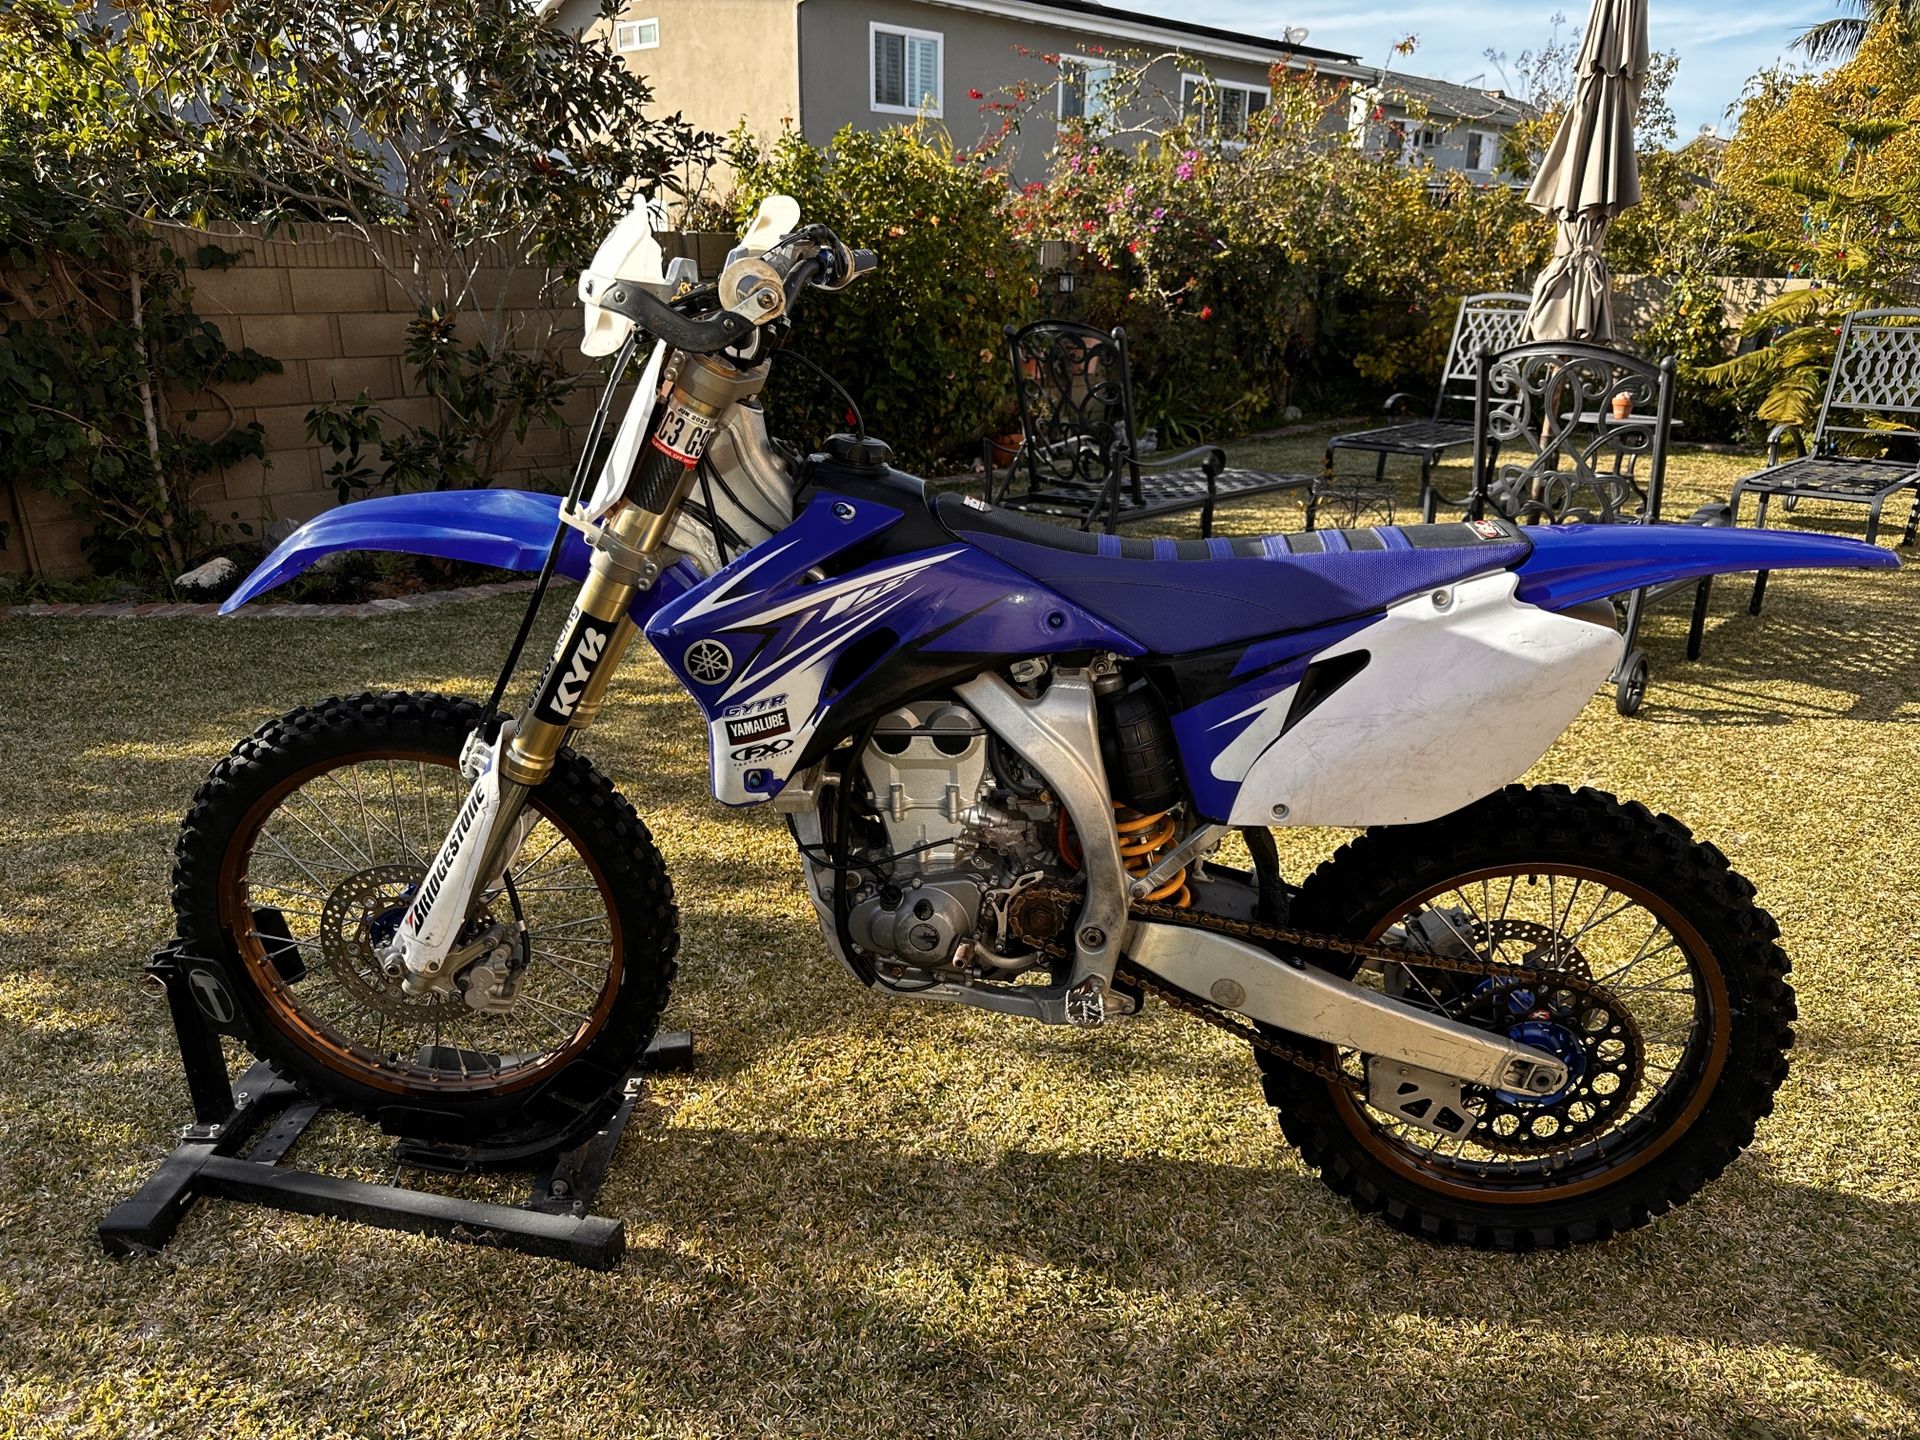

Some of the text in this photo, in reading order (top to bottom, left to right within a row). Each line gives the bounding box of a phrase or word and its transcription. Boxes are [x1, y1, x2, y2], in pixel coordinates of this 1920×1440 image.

[658, 409, 685, 447] C3
[677, 407, 709, 426] JUN 2022
[549, 627, 607, 717] KYB
[722, 692, 789, 719] GYTR
[729, 712, 786, 737] YAMALUBE
[730, 739, 794, 761] FX
[408, 782, 486, 937] BRIDGESTONE
